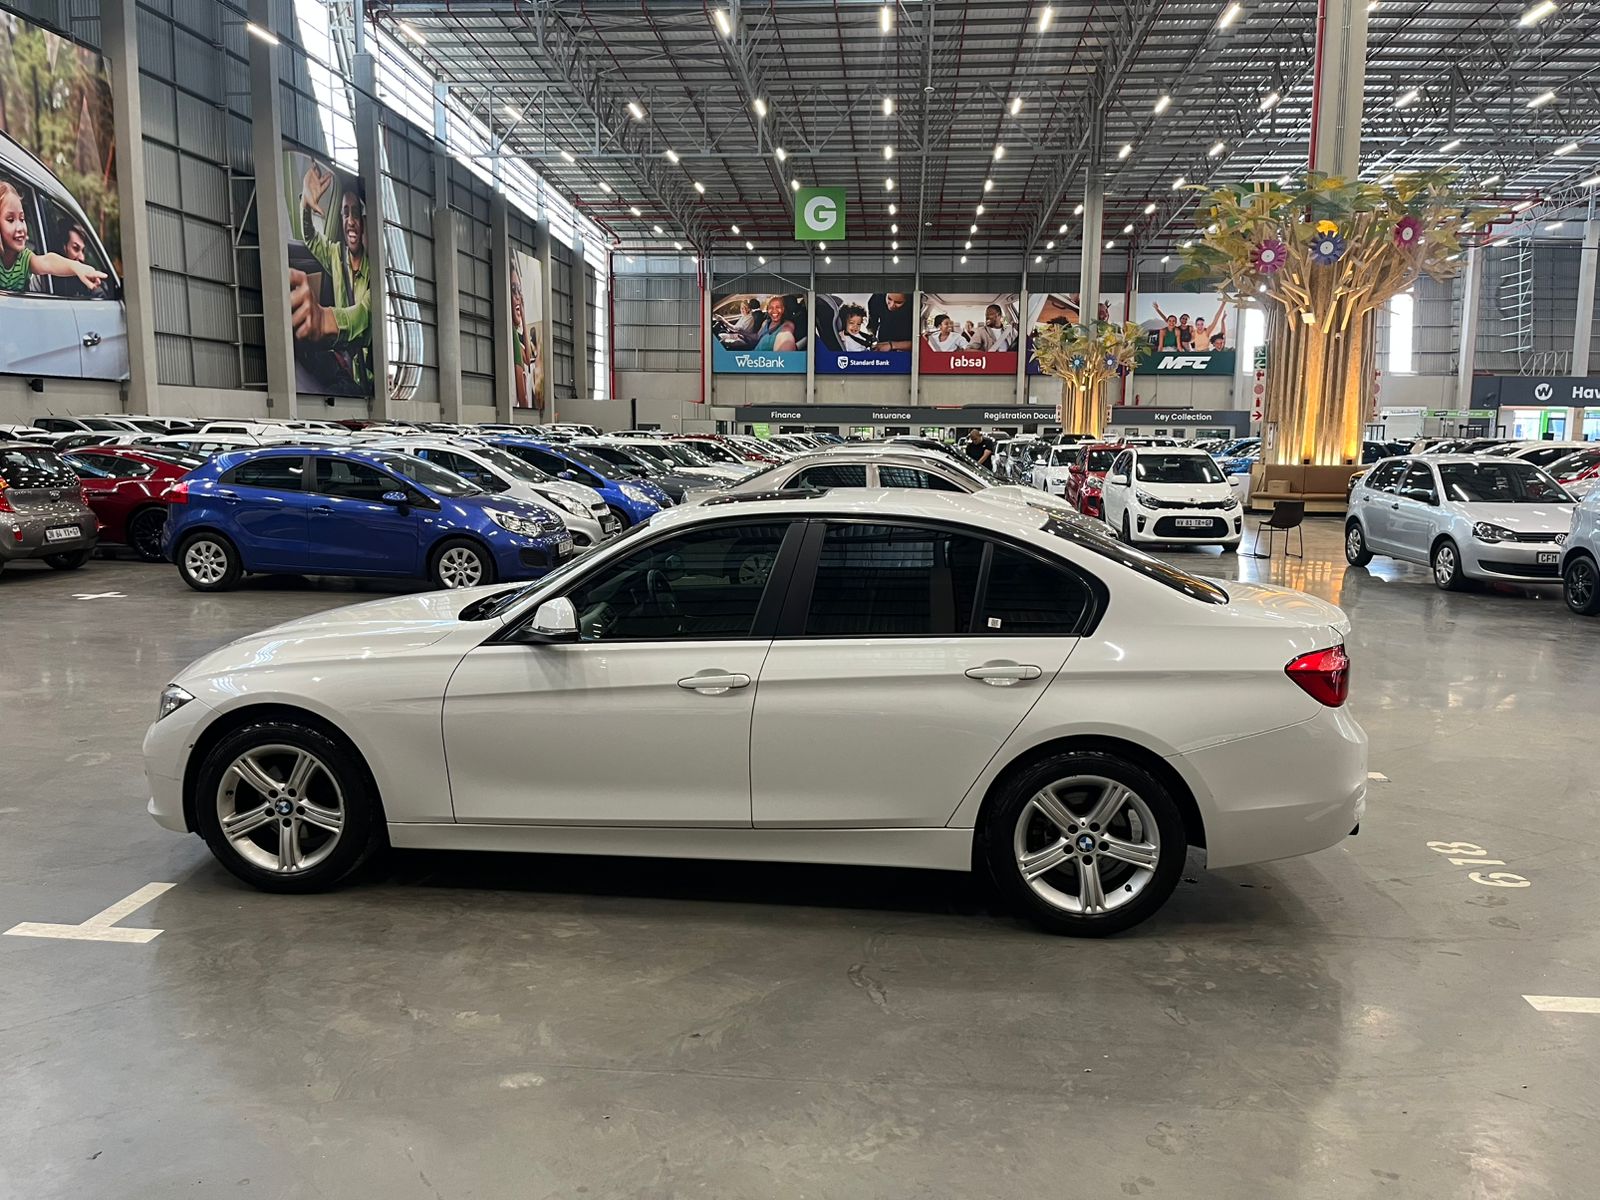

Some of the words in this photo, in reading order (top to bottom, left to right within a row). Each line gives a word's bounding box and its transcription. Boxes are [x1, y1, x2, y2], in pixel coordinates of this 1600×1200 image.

[804, 195, 837, 231] G
[735, 354, 785, 368] WesBank
[950, 355, 986, 370] (absa)
[1157, 355, 1213, 370] MFC
[771, 411, 801, 419] Finance
[872, 411, 911, 420] Insurance
[984, 411, 1032, 421] Registration
[1154, 413, 1170, 422] Key
[1171, 413, 1212, 421] Collection
